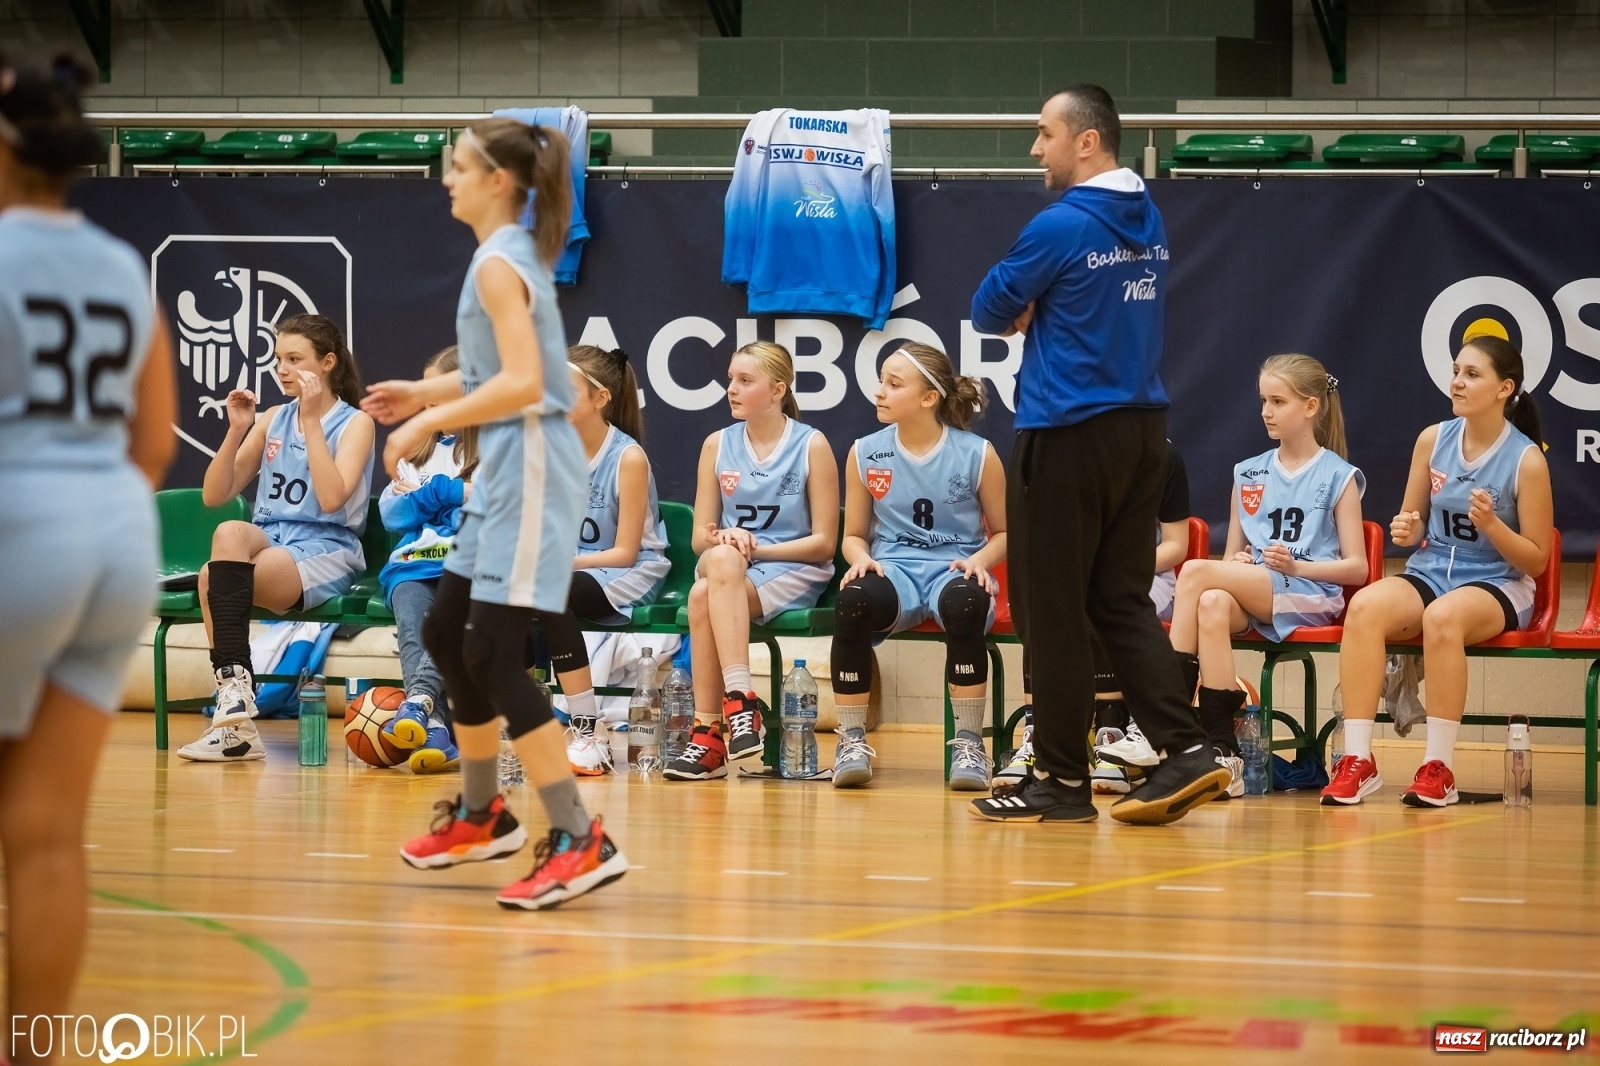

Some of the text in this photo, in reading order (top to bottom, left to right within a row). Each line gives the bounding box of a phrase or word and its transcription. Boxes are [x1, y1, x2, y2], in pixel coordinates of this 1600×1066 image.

[788, 116, 848, 134] TOKARSKA
[815, 149, 864, 167] WISŁA
[24, 294, 133, 420] 32
[1421, 275, 1600, 411] OS
[1576, 429, 1600, 462] R
[268, 472, 308, 505] 30
[735, 504, 781, 531] 27
[912, 498, 934, 531] 8
[1267, 507, 1305, 543] 13
[1442, 509, 1479, 543] 18
[420, 547, 449, 559] SKOLN
[844, 672, 859, 682] NBA
[960, 663, 975, 674] NBA
